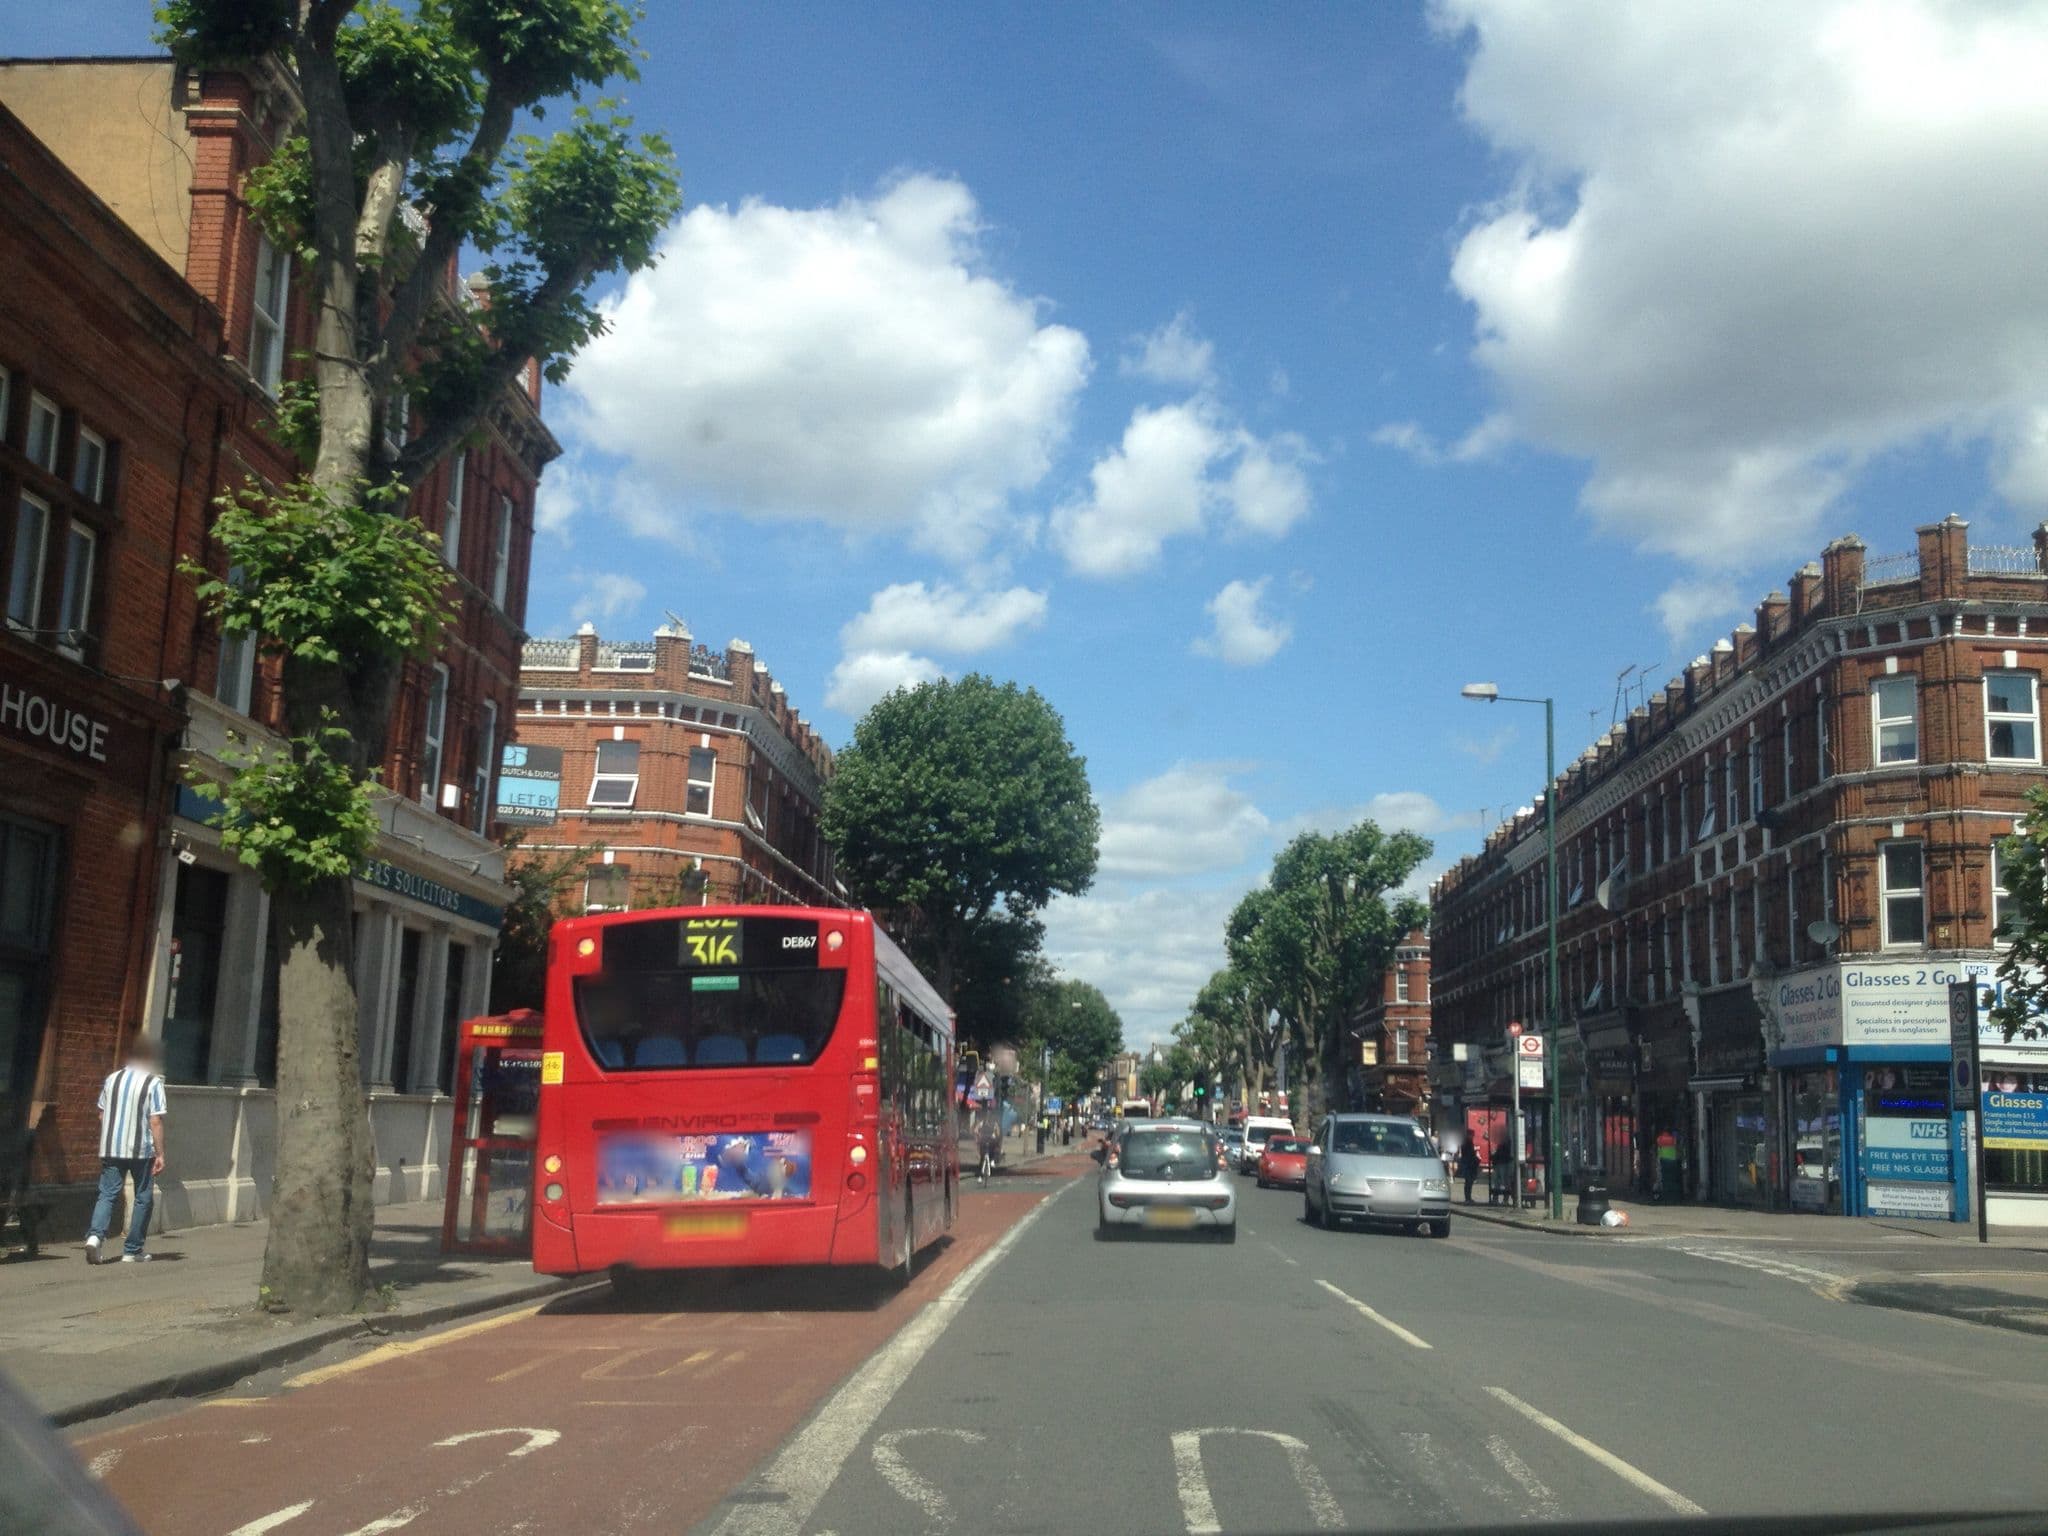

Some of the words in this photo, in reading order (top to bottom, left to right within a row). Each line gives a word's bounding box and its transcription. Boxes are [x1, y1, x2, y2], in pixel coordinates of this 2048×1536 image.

[1, 683, 109, 762] HOUSE
[501, 768, 527, 776] DUTCH
[534, 770, 560, 778] DUTCH
[510, 793, 536, 804] LET
[538, 795, 557, 807] BY
[394, 869, 460, 910] SOLICITORS
[782, 936, 817, 949] DE867
[686, 935, 738, 965] 316
[1966, 966, 1988, 975] NHS
[1846, 972, 1910, 987] Glasses
[1916, 971, 1927, 985] 2
[1932, 970, 1957, 985] Go
[1781, 984, 1815, 1007] Glasses
[1817, 977, 1824, 1000] 2
[1826, 974, 1840, 998] Go
[1851, 999, 1891, 1007] Discounted
[1891, 999, 1924, 1008] designer
[1924, 1000, 1950, 1008] glasse
[1978, 1025, 1993, 1035] ye
[1990, 1094, 2043, 1109] Glasses
[1912, 1123, 1948, 1137] NHS
[1870, 1151, 1889, 1160] FREE
[1892, 1152, 1910, 1160] NHS
[1911, 1152, 1927, 1161] EYE
[1872, 1164, 1890, 1172] FREE
[1894, 1164, 1911, 1172] NHS
[1913, 1165, 1948, 1174] GLASSES
